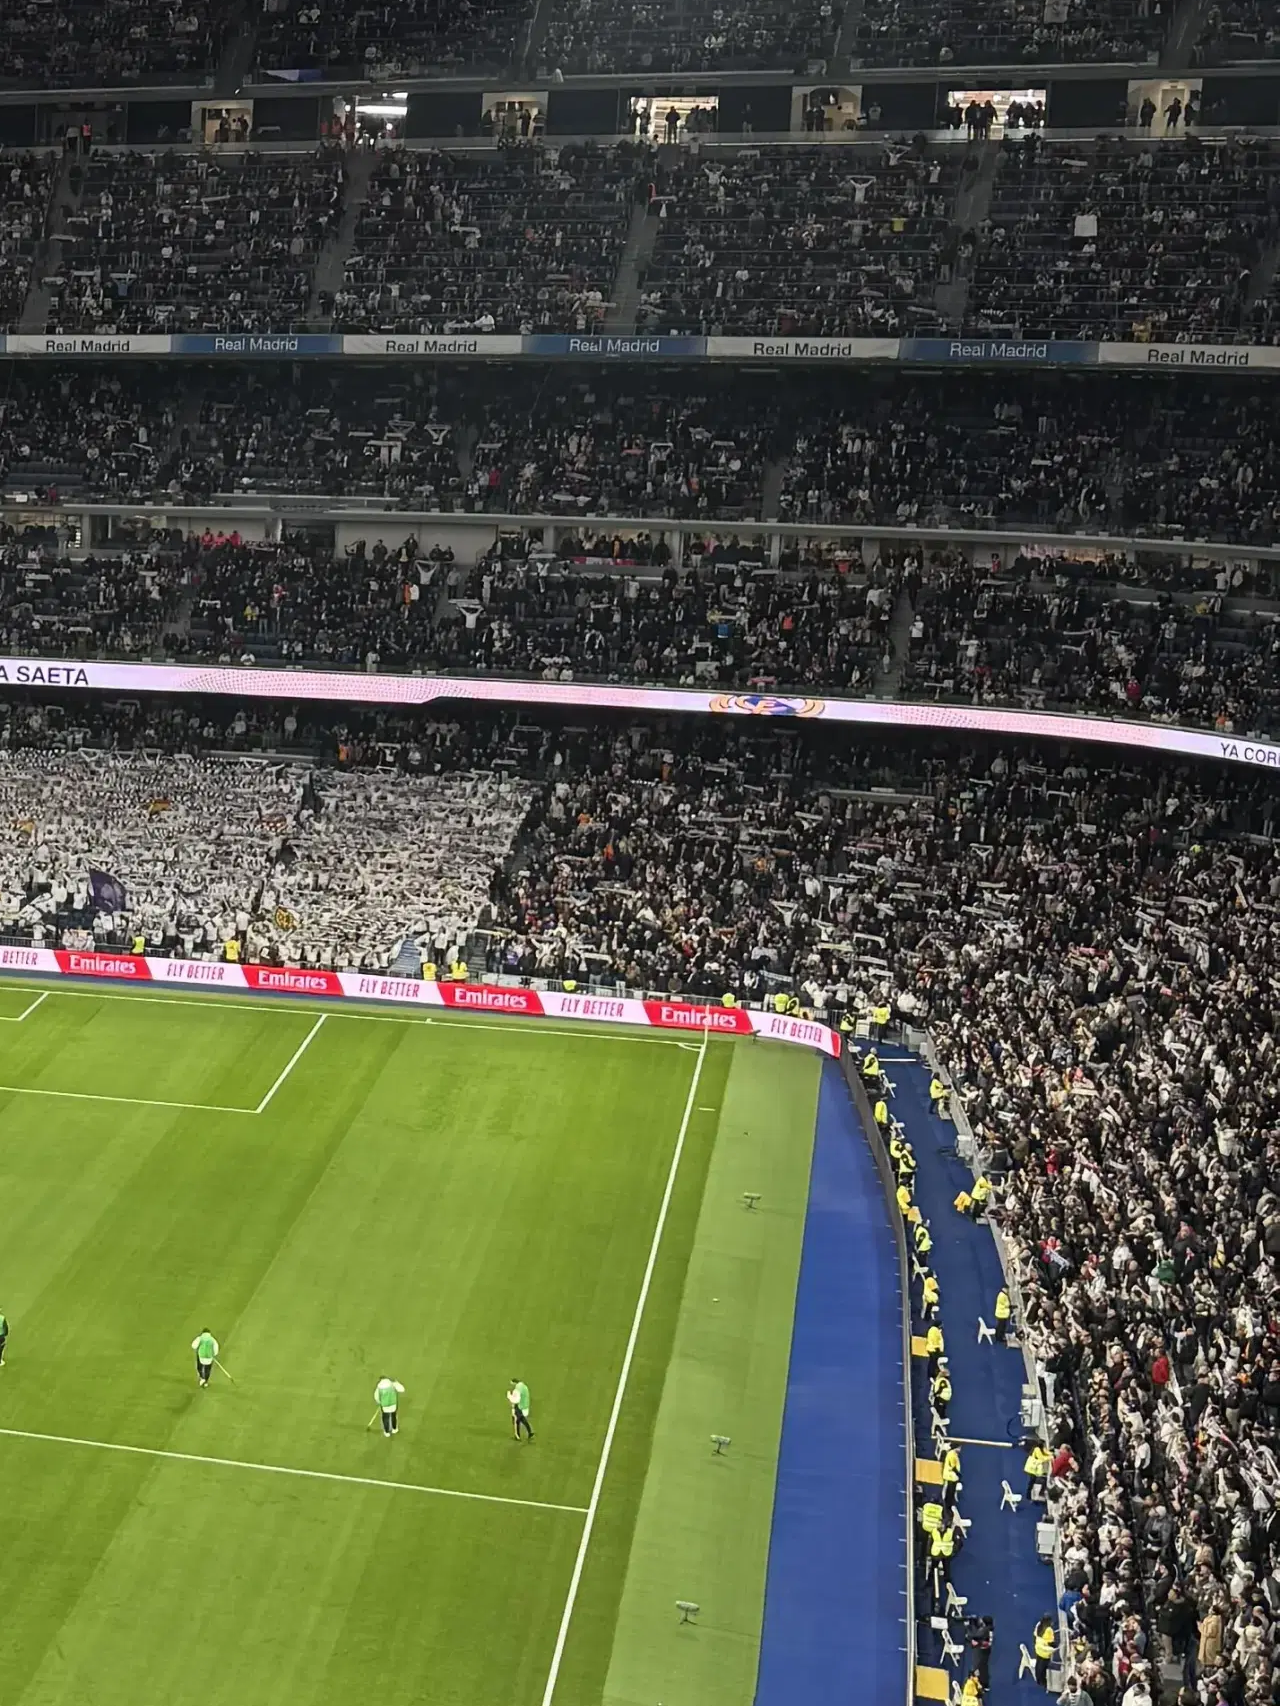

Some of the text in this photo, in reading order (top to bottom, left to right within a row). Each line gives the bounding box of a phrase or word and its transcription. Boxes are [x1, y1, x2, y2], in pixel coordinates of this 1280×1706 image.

[46, 338, 130, 351] Real Madrid
[215, 336, 298, 350] Real Madrid
[386, 339, 477, 353] Real Madrid
[570, 339, 660, 353] Real Madrid
[754, 342, 852, 356] Real Madrid
[950, 342, 1047, 358] Real Madrid
[1148, 348, 1249, 365] Real Madrid
[17, 666, 89, 686] SAETA
[1221, 742, 1280, 766] YA COR
[2, 950, 38, 966] BETTER
[70, 959, 136, 976] Emirates
[167, 962, 225, 980] FLY BETTER
[258, 973, 327, 991] Emirates
[359, 978, 420, 998] FLY BETTER
[454, 988, 528, 1009] Emirates
[561, 995, 624, 1019] FLY BETTER
[661, 1009, 738, 1028] Emirates
[770, 1017, 790, 1036] FLY
